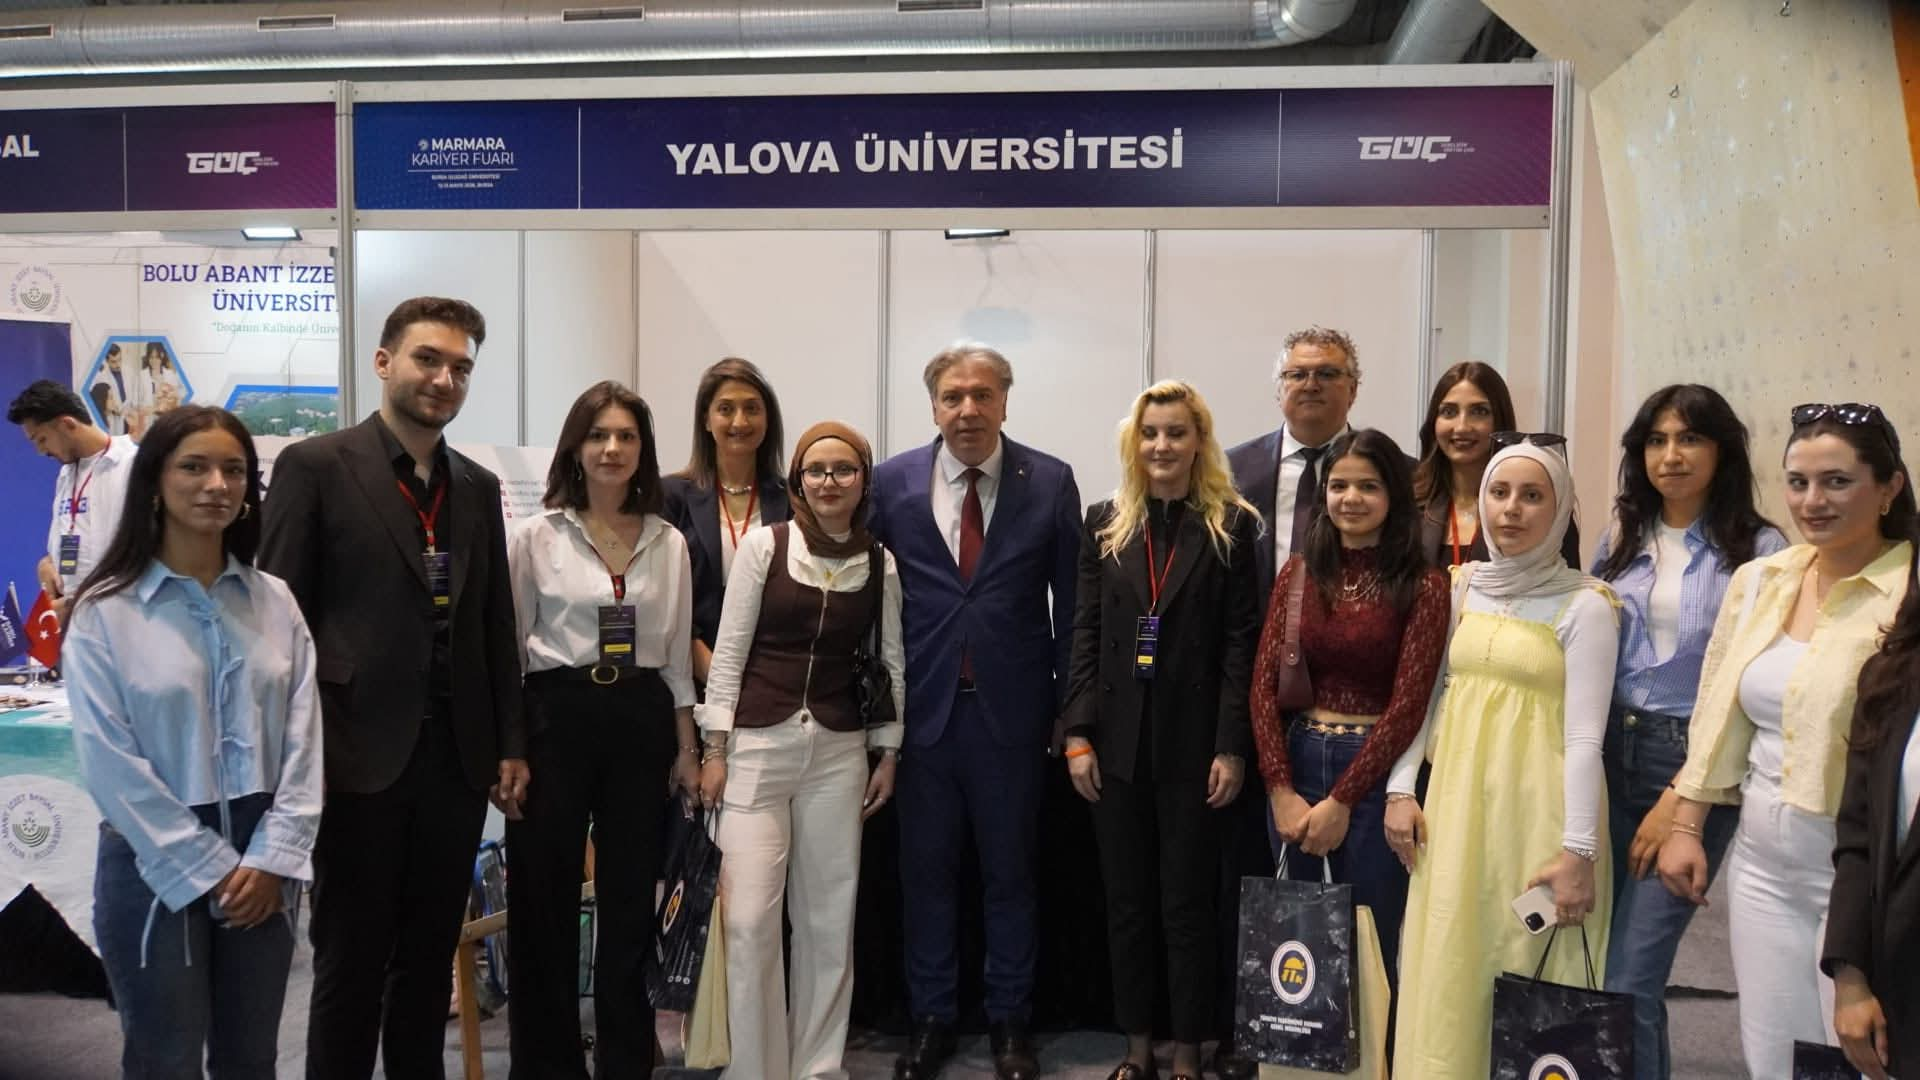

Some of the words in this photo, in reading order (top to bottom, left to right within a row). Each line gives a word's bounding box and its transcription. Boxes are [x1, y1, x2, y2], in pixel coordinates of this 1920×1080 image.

[0, 135, 40, 158] AL
[431, 137, 505, 151] MARMARA
[665, 142, 840, 175] YALOVA
[855, 127, 1183, 172] ÜNİVERSİTESİ
[412, 150, 469, 166] KARİYER
[473, 151, 514, 165] FUARI
[143, 264, 198, 282] BOLU
[204, 265, 283, 283] ABANT
[212, 289, 338, 312] ÜNİVERSİT
